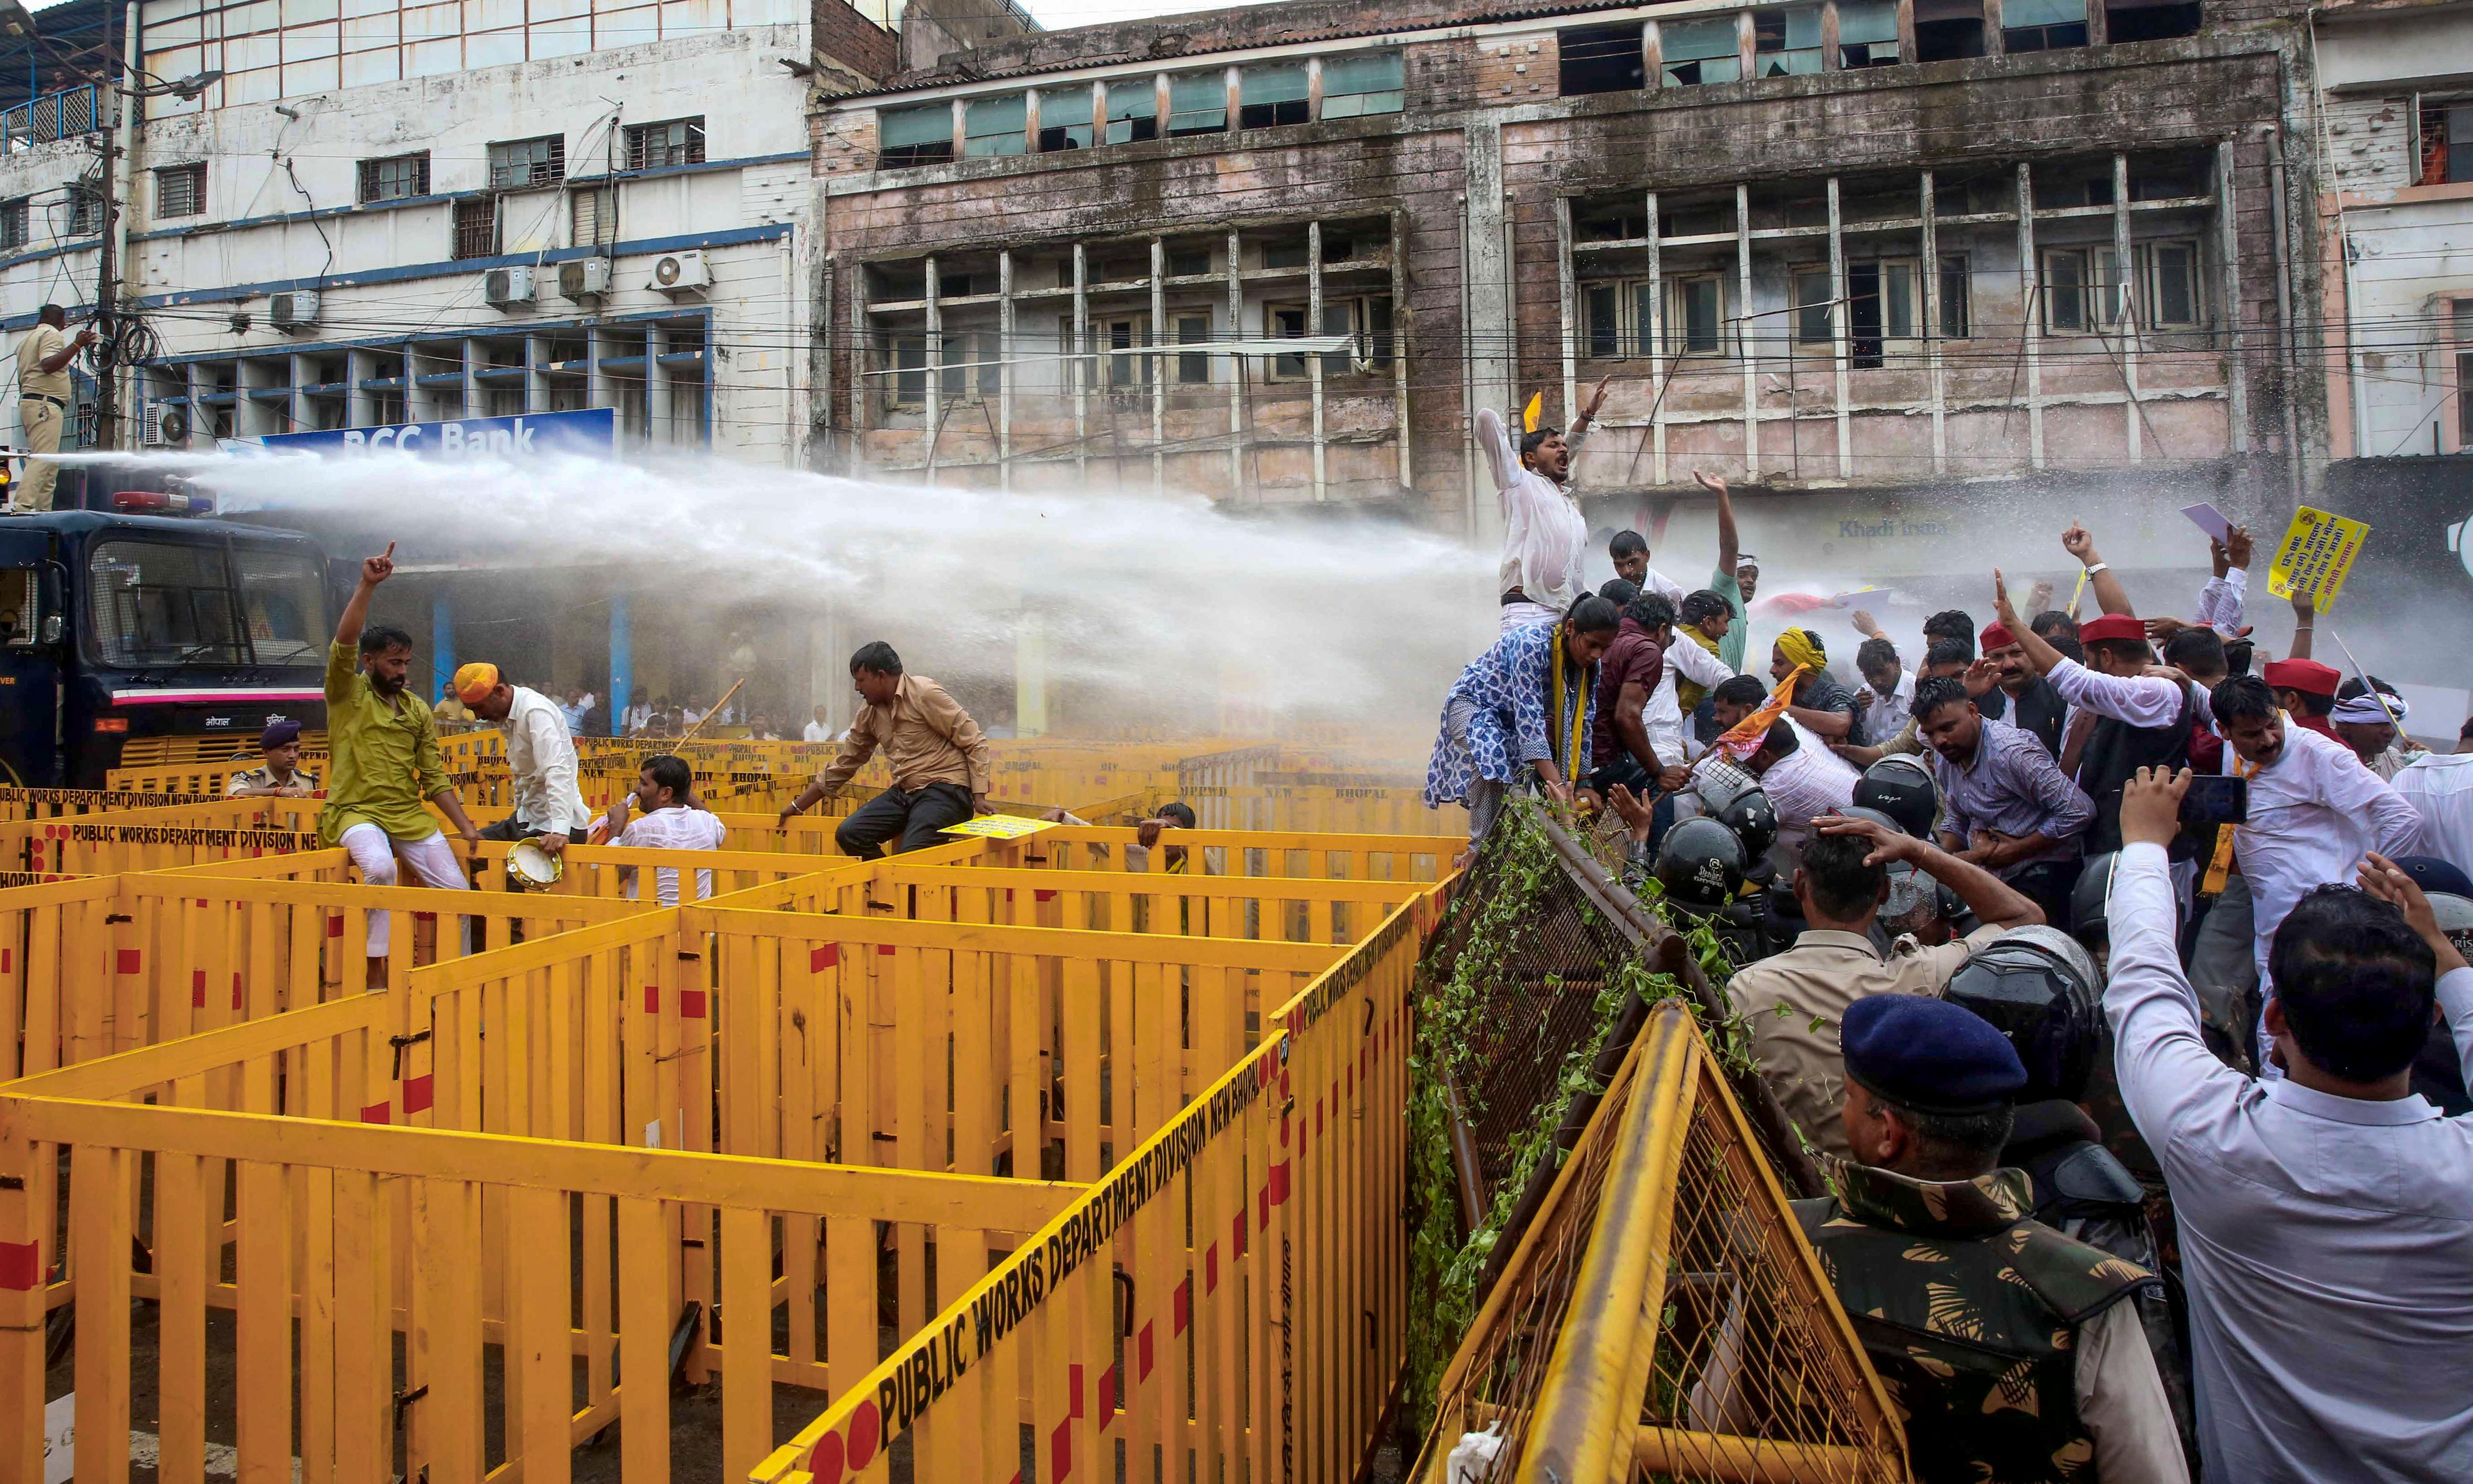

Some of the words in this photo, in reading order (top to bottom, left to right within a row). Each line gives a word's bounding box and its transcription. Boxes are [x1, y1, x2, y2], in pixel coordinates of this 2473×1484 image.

[442, 418, 535, 454] Bank
[1839, 517, 1894, 538] Khadi
[2304, 522, 2322, 550] आरक्षण
[2281, 552, 2294, 567] 13%
[2289, 535, 2302, 551] OBC
[2302, 562, 2314, 576] रोक
[2322, 516, 2338, 536] मोहन
[2337, 541, 2355, 569] महासभा
[206, 717, 230, 727] भोपाल
[266, 714, 287, 726] पुलिस
[585, 737, 609, 747] PUBLIC
[610, 738, 633, 748] WORKS
[635, 740, 684, 751] DEPARTMEN
[806, 745, 833, 755] PUBLIC
[477, 756, 511, 764] BHOPA
[583, 769, 604, 778] NEW
[695, 772, 713, 781] DIV
[28, 789, 60, 803] WORKS
[62, 790, 126, 807] DEPARTMENT
[128, 792, 171, 808] DIVISION
[171, 793, 192, 805] NEW
[73, 824, 115, 842] PUBLIC
[119, 826, 159, 844] WORKS
[161, 829, 237, 848] DEPARTMENT
[240, 830, 296, 850] DIVISION
[301, 833, 318, 851] NE
[1303, 979, 1326, 1030] PUBLIC
[1326, 964, 1345, 1008] WORKS
[878, 1313, 967, 1452] PUBLIC
[971, 1246, 1044, 1360] WORKS
[1048, 1149, 1152, 1294] DEPARTMENT
[1154, 1104, 1206, 1193] DIVISION
[1210, 1081, 1230, 1140] NEW
[1231, 1059, 1260, 1119] BHOPAL
